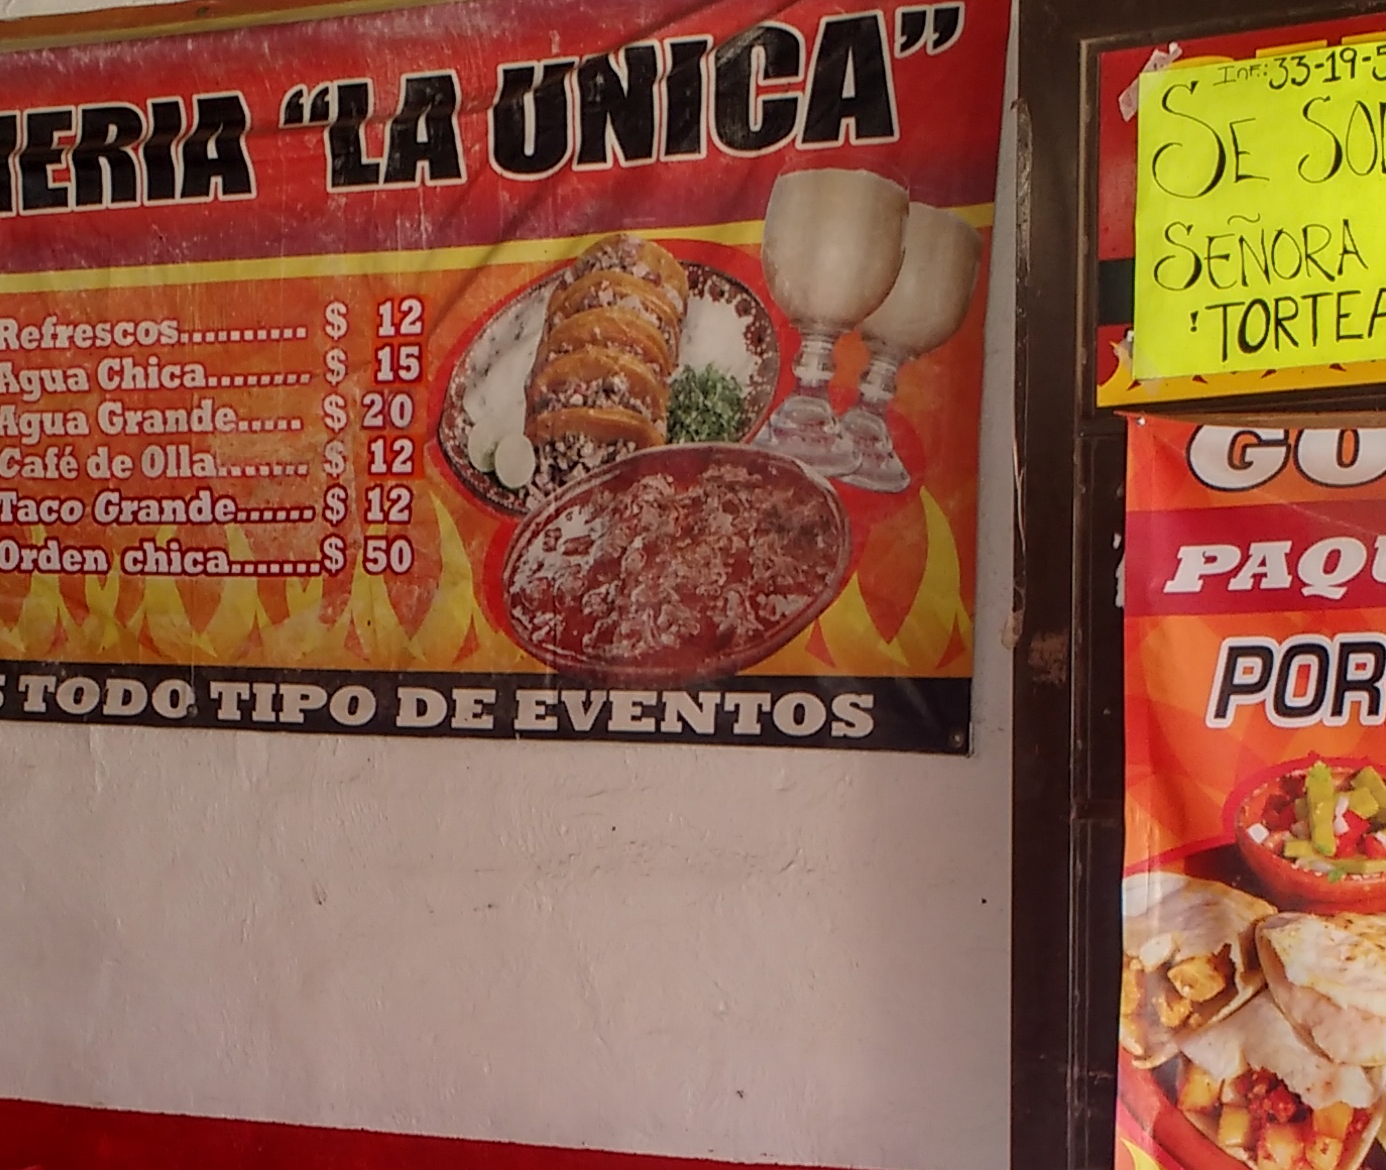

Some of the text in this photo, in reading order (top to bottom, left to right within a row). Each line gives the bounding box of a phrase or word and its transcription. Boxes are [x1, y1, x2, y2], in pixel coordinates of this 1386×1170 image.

[1152, 80, 1270, 198] SE
[1154, 213, 1369, 291] SEÑORA
[378, 299, 423, 337] 12
[377, 345, 420, 381] 15
[363, 393, 413, 428] 20
[87, 447, 133, 479] de
[369, 439, 413, 474] 12
[366, 487, 411, 523] 12
[364, 539, 413, 573] 50
[18, 674, 195, 718] TODO
[211, 682, 377, 729] TIPO
[396, 686, 495, 731] DE
[514, 688, 875, 740] EVENTOS
